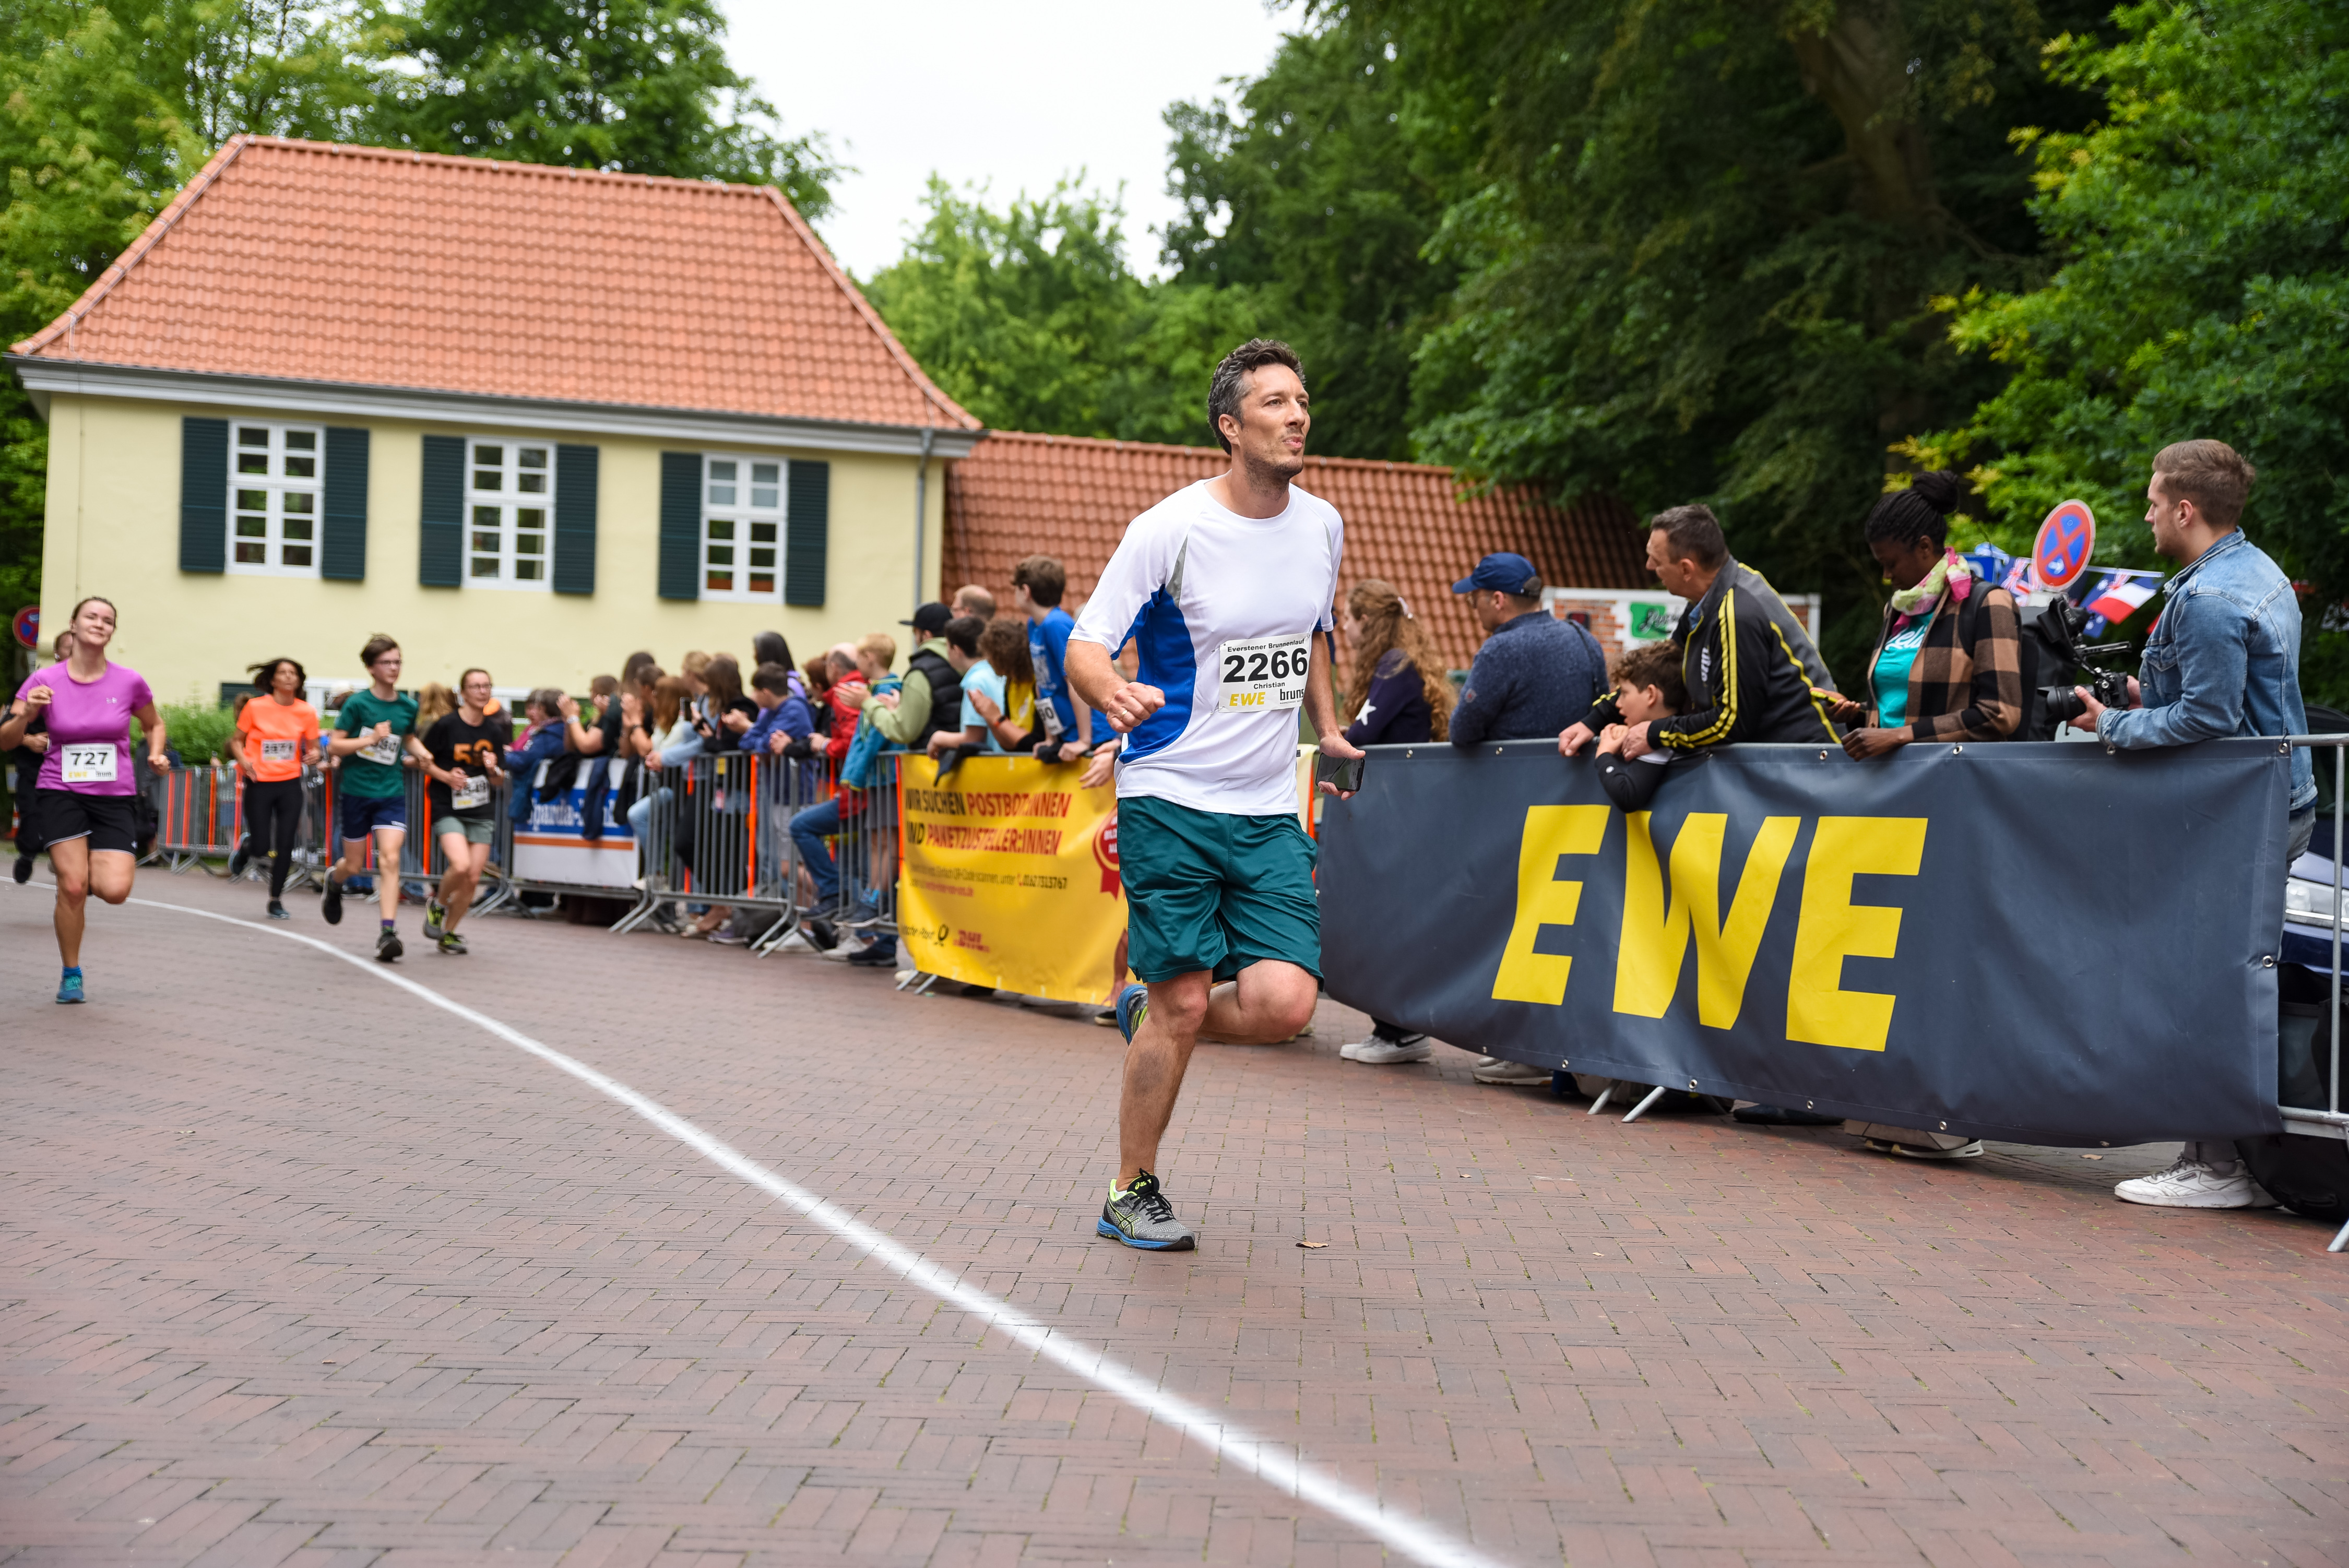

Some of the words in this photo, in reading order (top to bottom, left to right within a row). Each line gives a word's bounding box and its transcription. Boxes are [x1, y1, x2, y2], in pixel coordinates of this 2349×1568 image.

[1268, 638, 1305, 649] Brunnenlauf
[1223, 648, 1308, 683] 2266
[1229, 692, 1266, 706] EWE
[1280, 688, 1304, 700] bruns
[70, 752, 108, 766] 727
[922, 789, 965, 816] SUCHEN
[1491, 804, 1929, 1052] EWE
